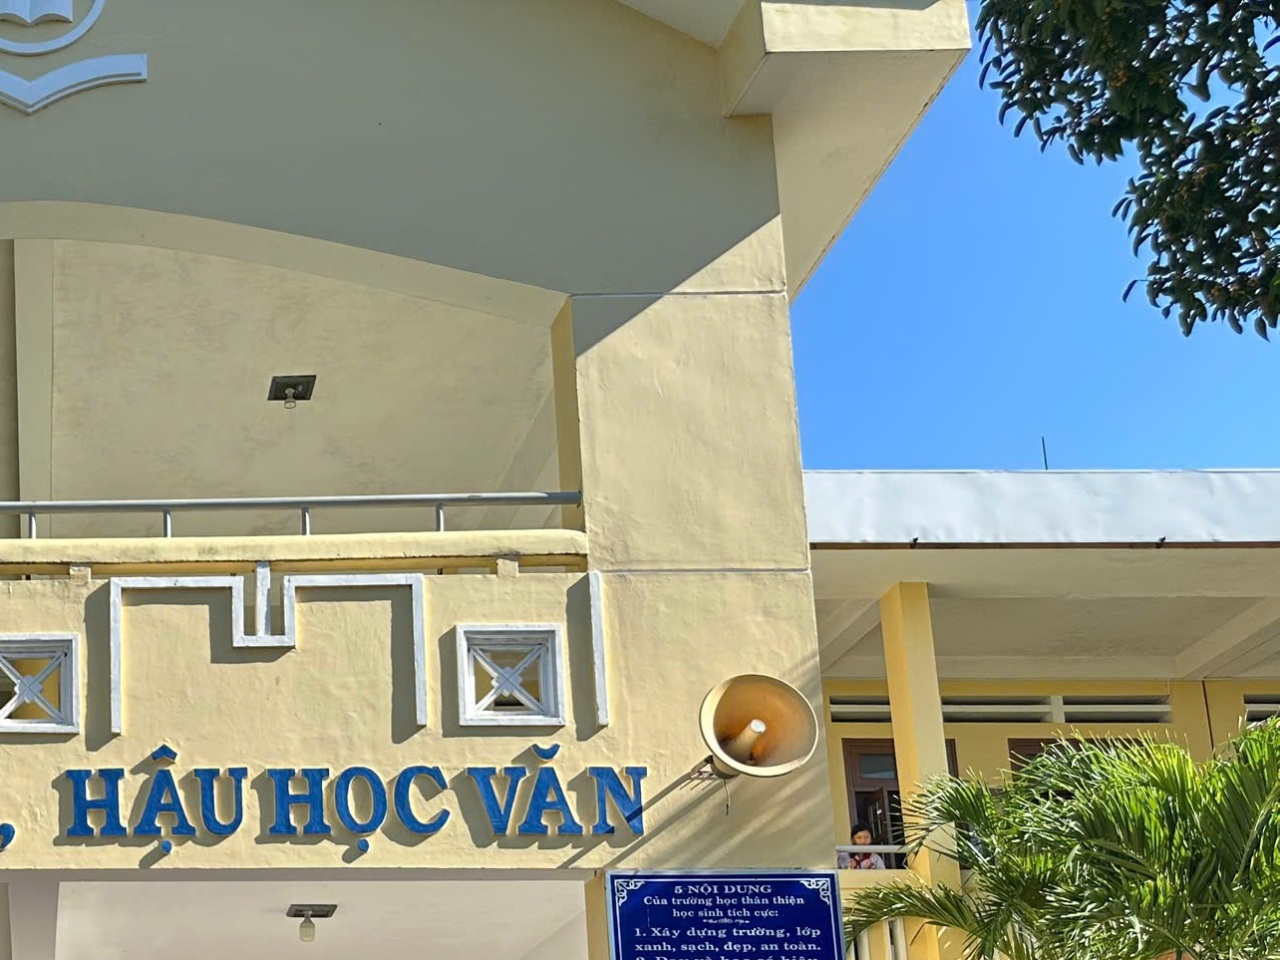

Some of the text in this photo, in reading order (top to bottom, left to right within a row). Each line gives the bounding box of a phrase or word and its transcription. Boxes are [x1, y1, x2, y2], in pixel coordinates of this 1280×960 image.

[65, 744, 248, 854] HẬU
[267, 765, 450, 853] HỌC
[467, 743, 648, 836] VĂN
[675, 886, 683, 894] 5
[688, 884, 718, 895] NỘI
[644, 895, 804, 906] Của trường học thân thiện
[673, 909, 778, 918] học sinh tích cực:
[635, 928, 821, 938] 1. Xây dựng trường, lớp
[635, 942, 676, 952] xanh,
[681, 942, 719, 953] sạch,
[724, 942, 756, 953] đẹp,
[783, 942, 821, 950] toàn.
